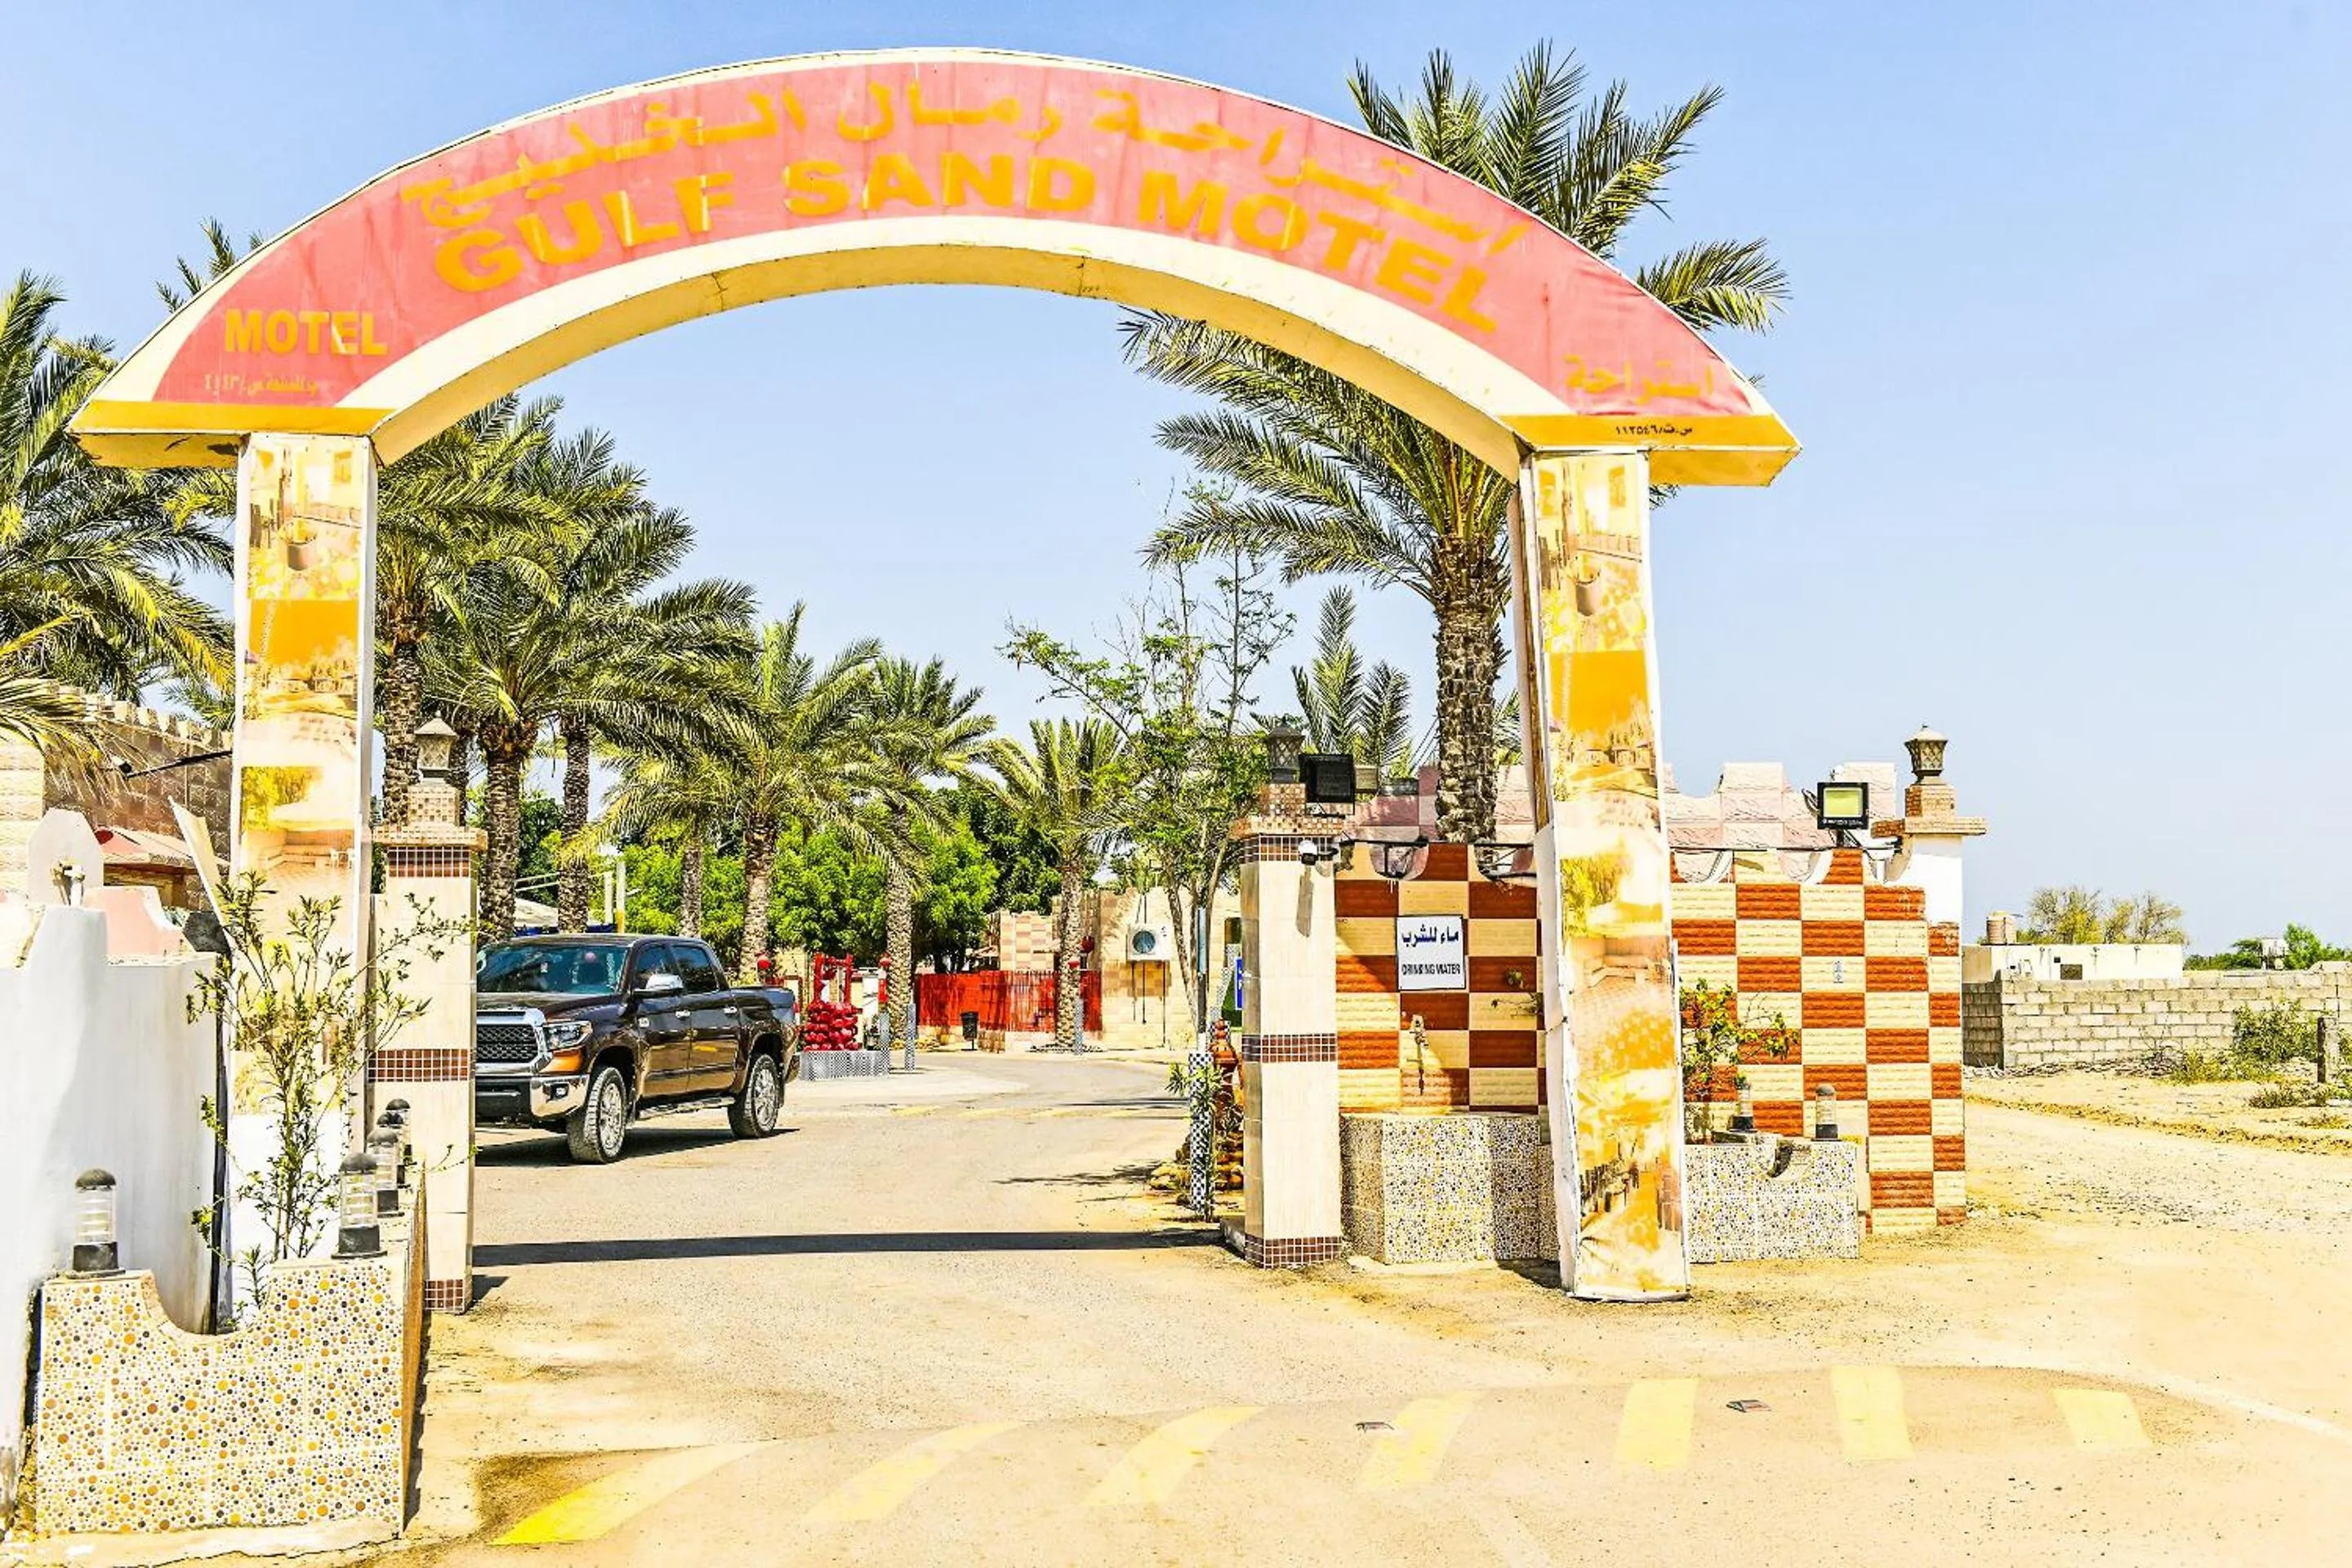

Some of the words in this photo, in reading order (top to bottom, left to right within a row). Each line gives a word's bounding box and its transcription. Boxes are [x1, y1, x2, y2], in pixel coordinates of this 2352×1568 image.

[434, 172, 733, 292] GULF
[783, 152, 1096, 216] SAND
[1137, 170, 1497, 334] MOTEL
[225, 308, 388, 355] MOTEL
[1401, 924, 1437, 947] للشرب
[1440, 926, 1459, 944] ماء
[1436, 964, 1460, 974] WATER
